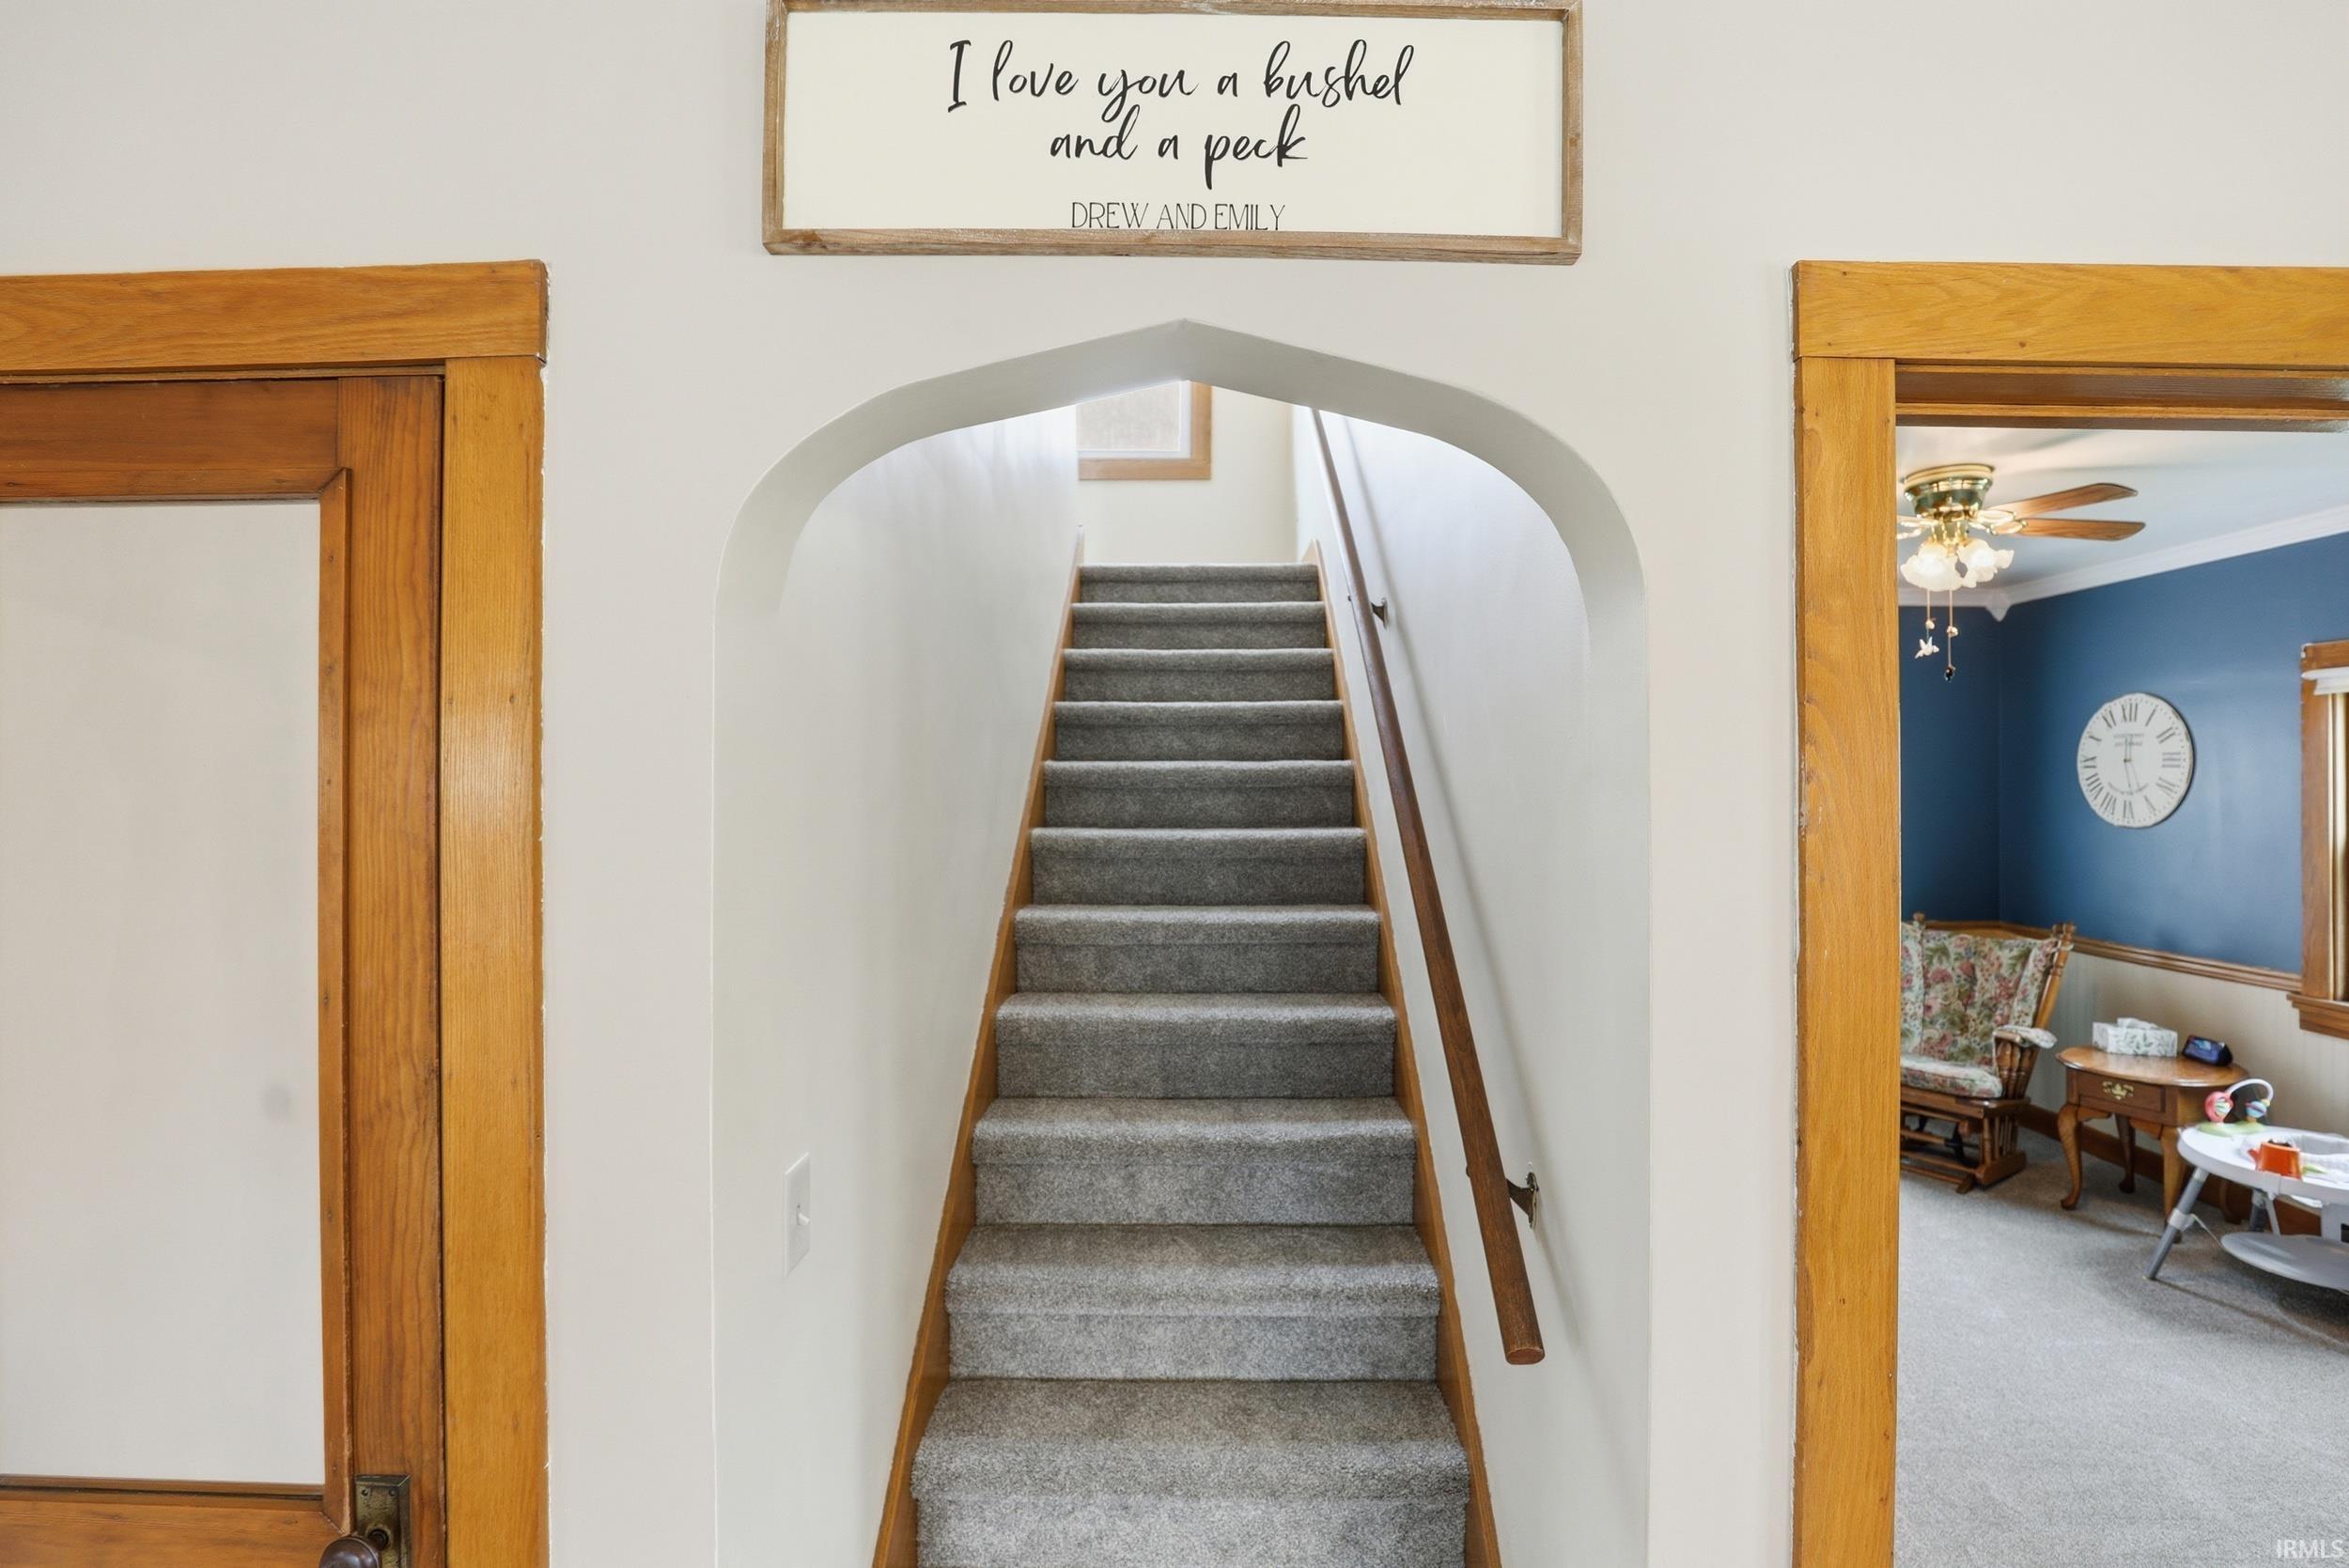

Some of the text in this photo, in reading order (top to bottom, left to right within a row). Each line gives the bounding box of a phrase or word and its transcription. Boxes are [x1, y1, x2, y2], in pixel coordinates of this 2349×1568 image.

[947, 39, 1415, 124] I love you a bushel
[1050, 104, 1309, 191] and a peck
[1071, 201, 1286, 231] DREW AND EMILY
